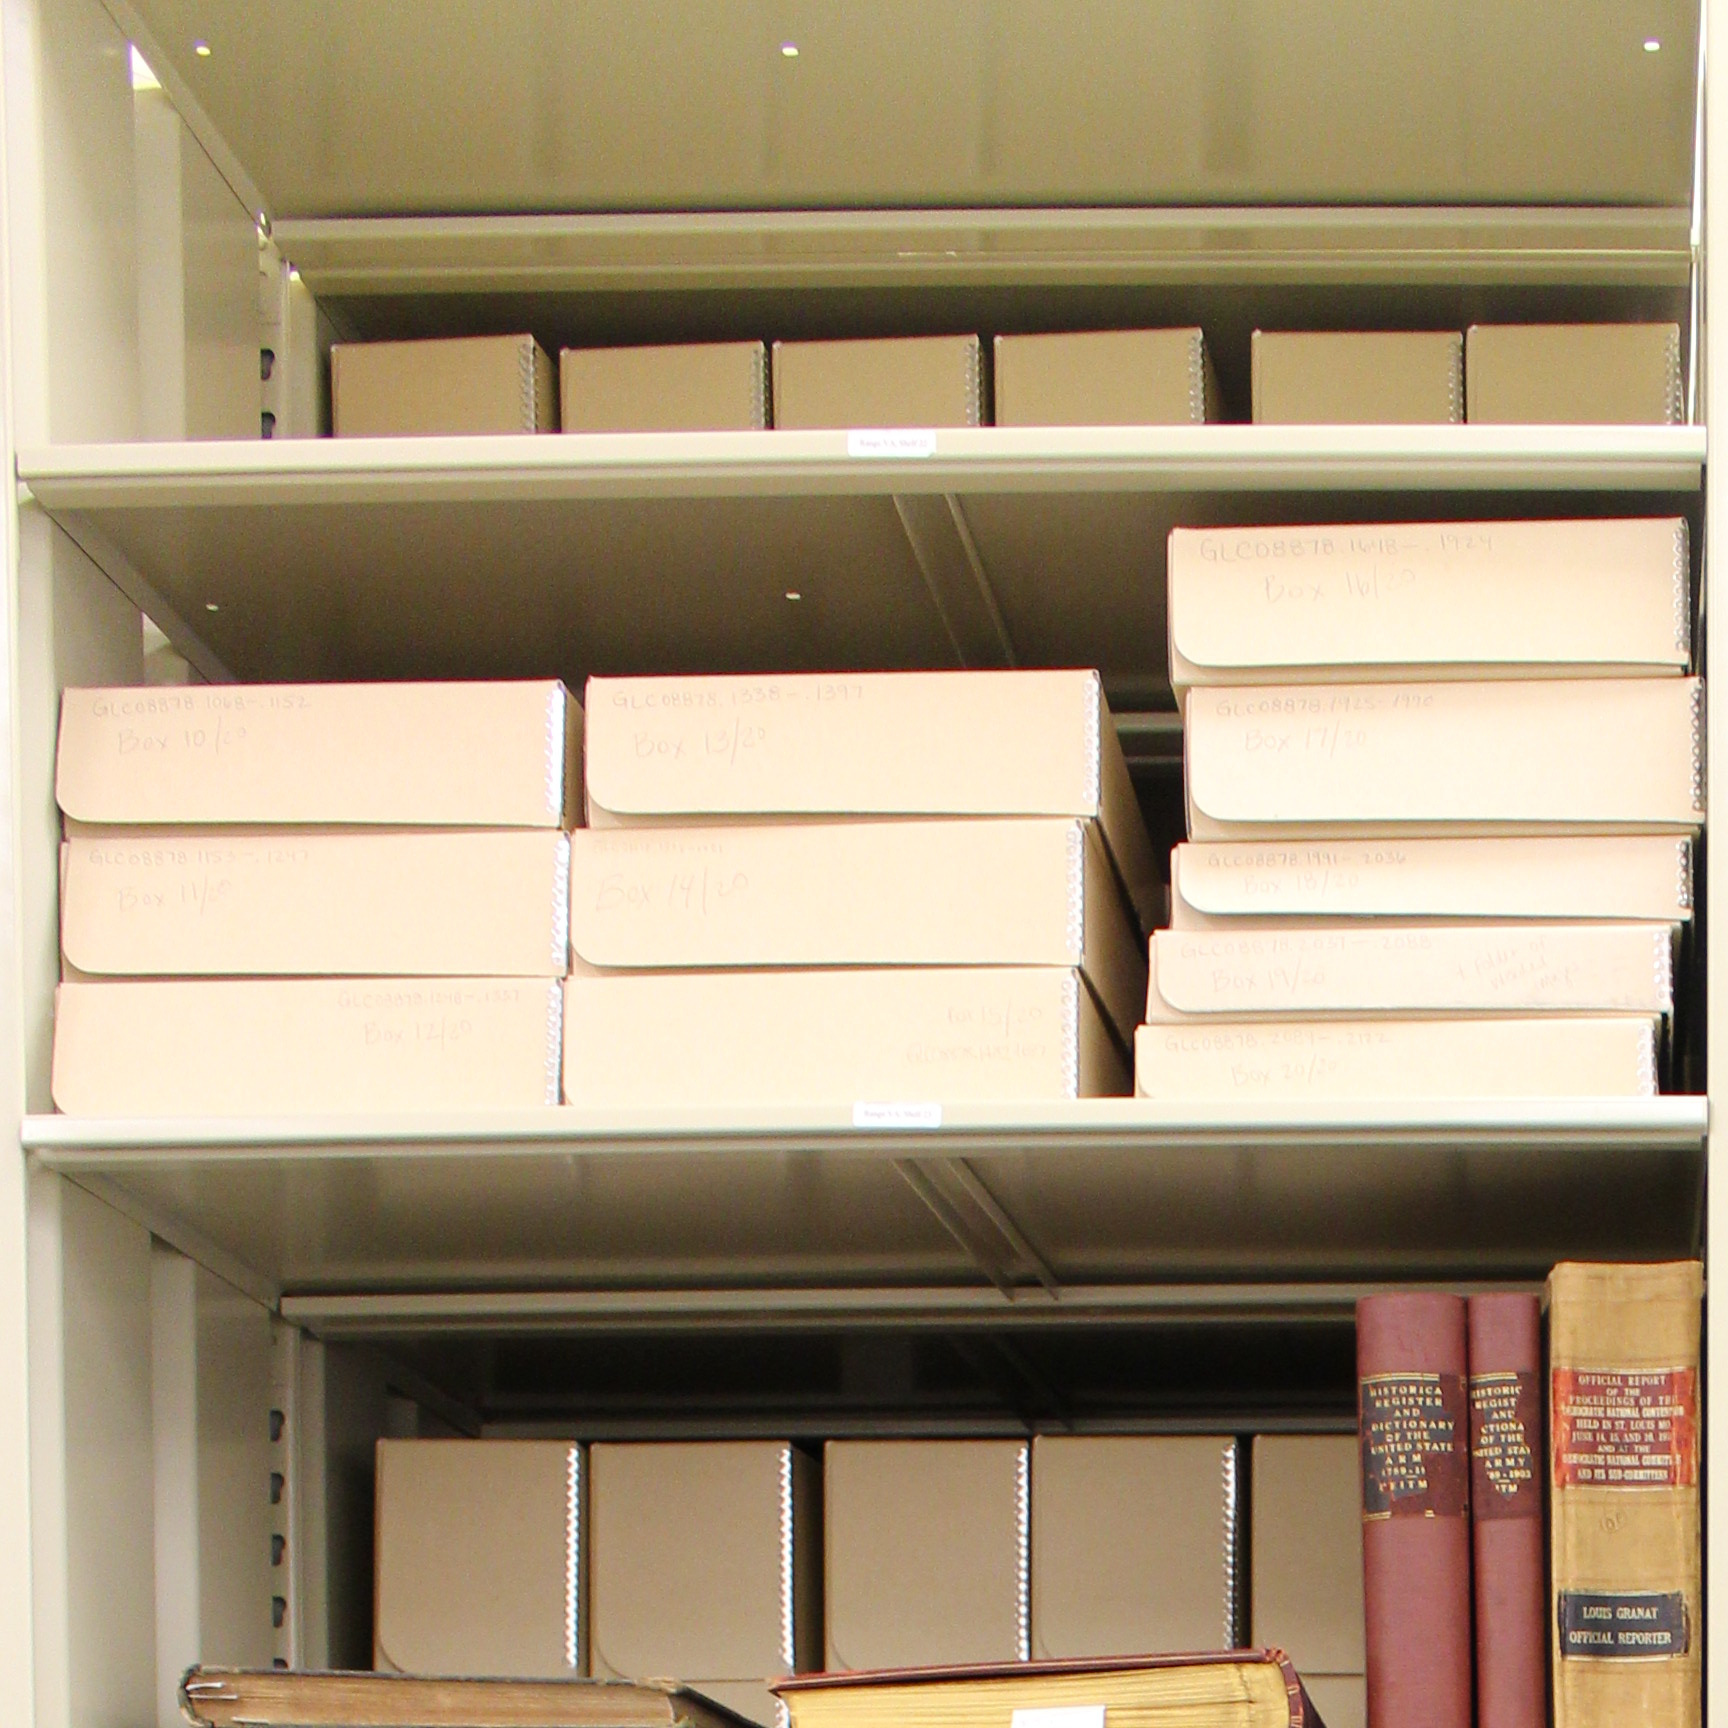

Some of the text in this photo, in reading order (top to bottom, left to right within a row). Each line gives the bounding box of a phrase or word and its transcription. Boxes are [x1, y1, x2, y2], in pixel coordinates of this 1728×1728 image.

[1264, 564, 1416, 603] Box 16/20
[118, 728, 168, 755] Box
[633, 716, 767, 766] Box 13/20
[1244, 719, 1367, 759] Box 17/20
[1243, 871, 1359, 897] Box 18/20
[595, 873, 652, 912] Box
[118, 886, 164, 912] Box
[1211, 968, 1257, 993] Box
[363, 1020, 403, 1045] Box
[1230, 1064, 1270, 1086] Box
[1578, 1375, 1666, 1386] OFFICIAL REPORT
[1369, 1386, 1442, 1397] HISTORICA
[1606, 1388, 1641, 1396] OF THE
[1375, 1397, 1442, 1408] REGISTER
[1569, 1396, 1635, 1406] PROCEEDINGS
[1640, 1396, 1652, 1406] OF
[1393, 1408, 1421, 1417] AND
[1606, 1407, 1640, 1418] NATIONAL
[1371, 1421, 1454, 1432] DICTIONARY
[1576, 1419, 1599, 1430] HELD
[1602, 1419, 1612, 1430] IN
[1630, 1420, 1655, 1430] LOUIS
[1385, 1430, 1430, 1442] OF THE
[1480, 1433, 1523, 1444] OF THE
[1572, 1432, 1641, 1442] JUNE AND
[1371, 1442, 1454, 1455] UNITED STATE
[1598, 1445, 1651, 1453] AND THE
[1484, 1457, 1525, 1468] ARMY
[1606, 1454, 1640, 1466] NATIONAL
[1583, 1606, 1658, 1619] LOUIS GRANAT
[1569, 1631, 1671, 1644] OFFICIAL REPORTER
